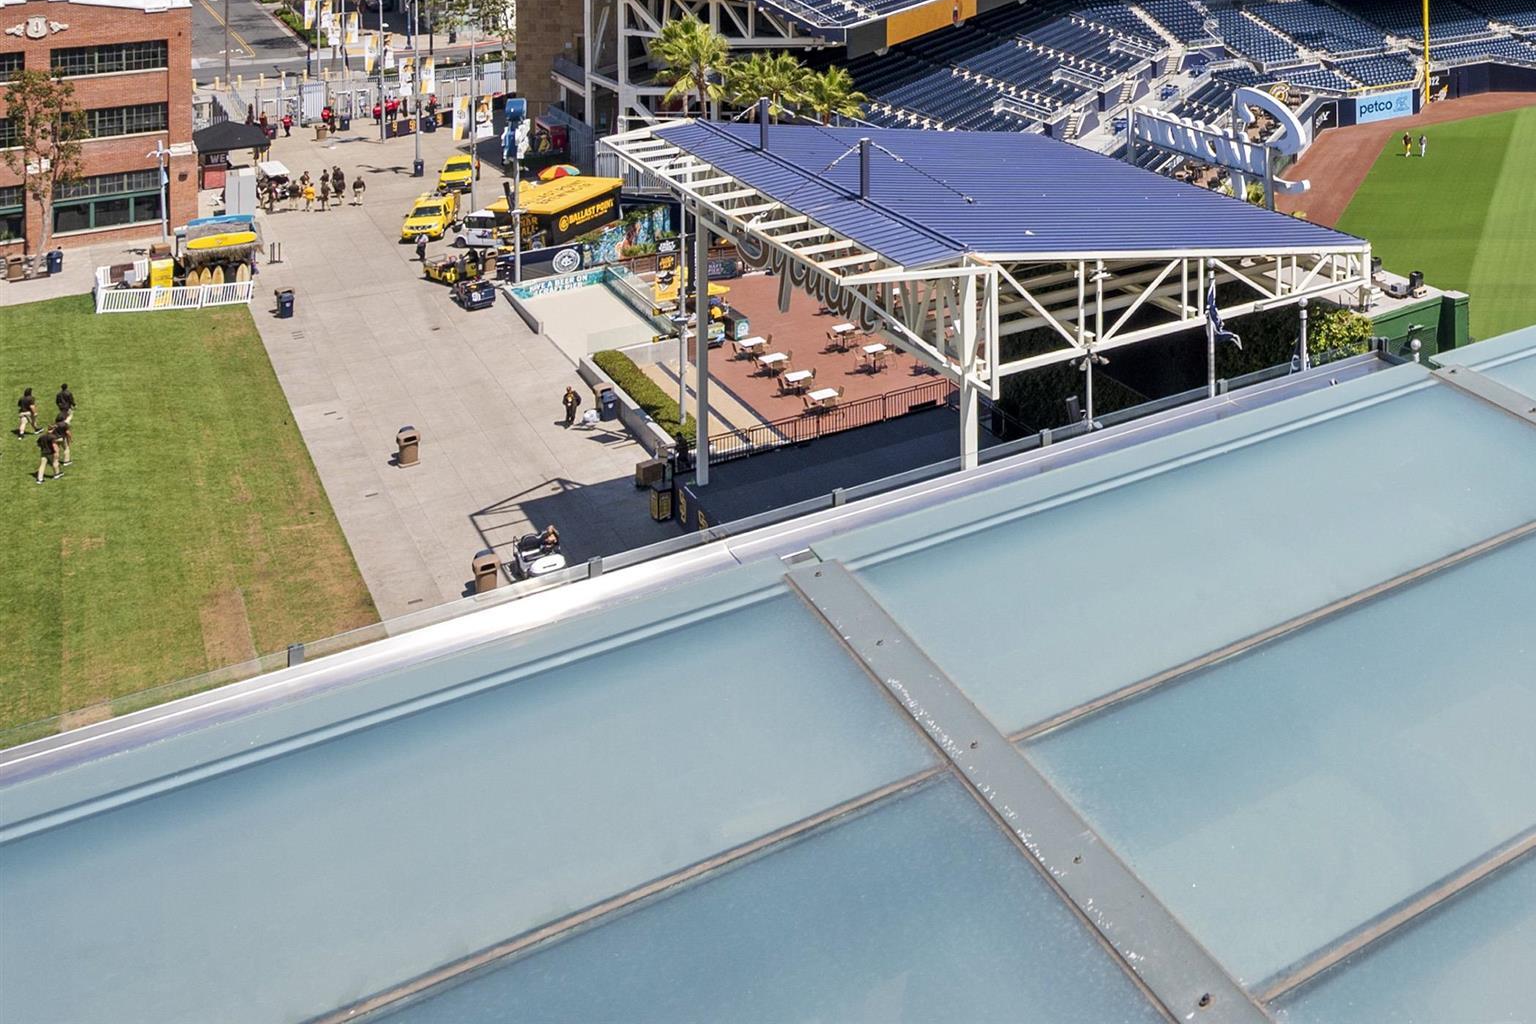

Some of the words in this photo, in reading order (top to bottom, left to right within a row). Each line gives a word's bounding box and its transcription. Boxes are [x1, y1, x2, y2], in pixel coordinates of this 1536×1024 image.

[1360, 100, 1393, 117] petco
[569, 205, 596, 225] BALLAST
[596, 198, 615, 213] POINT
[554, 276, 575, 287] BEER
